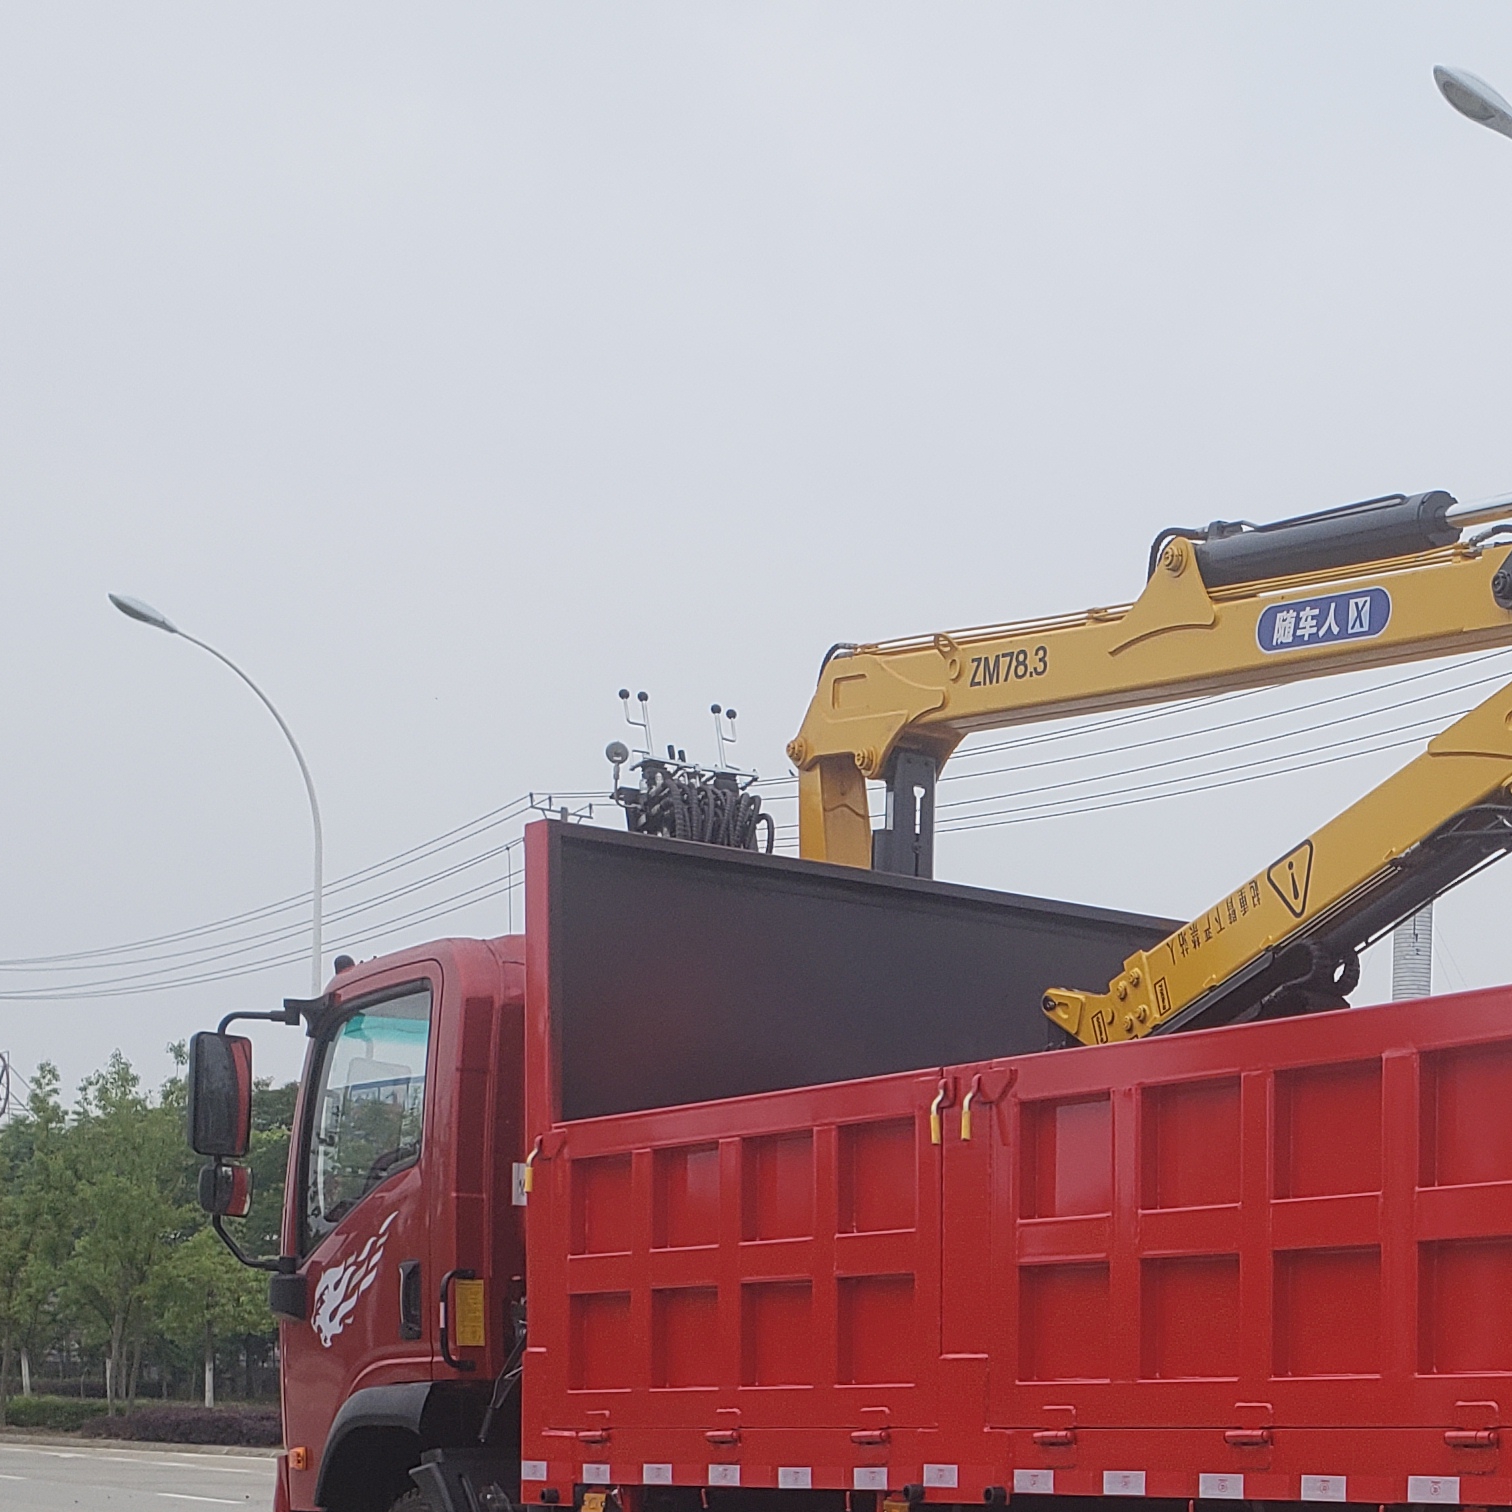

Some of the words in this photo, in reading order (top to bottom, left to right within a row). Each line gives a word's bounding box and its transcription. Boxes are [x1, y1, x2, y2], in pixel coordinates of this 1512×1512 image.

[1272, 602, 1340, 646] 随车人
[969, 645, 1048, 688] ZM78.3
[1166, 879, 1261, 966] 起重臂下严禁站人
